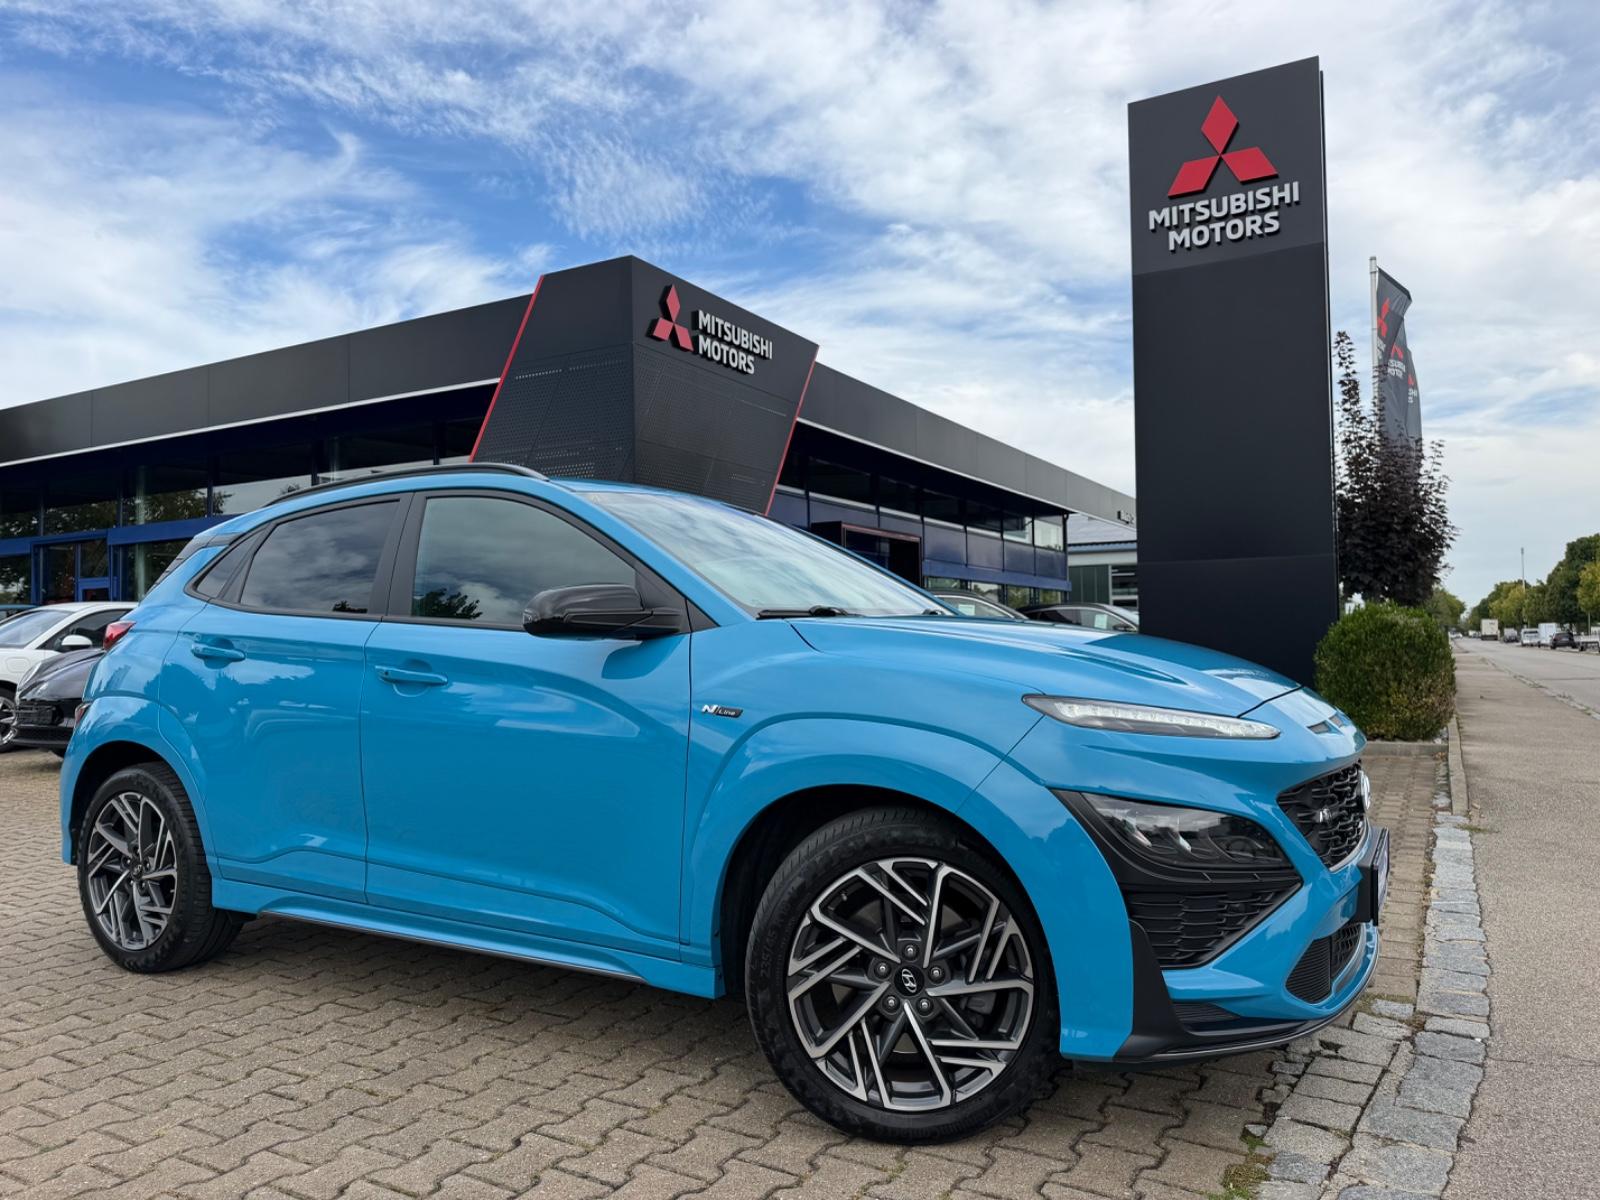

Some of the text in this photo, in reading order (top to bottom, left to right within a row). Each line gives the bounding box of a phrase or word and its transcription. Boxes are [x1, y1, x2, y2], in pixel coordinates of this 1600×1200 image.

[1149, 181, 1300, 230] MITSUBISHI
[1168, 211, 1280, 251] MOTORS
[698, 309, 773, 360] MITSUBISHI
[698, 336, 755, 375] MOTORS
